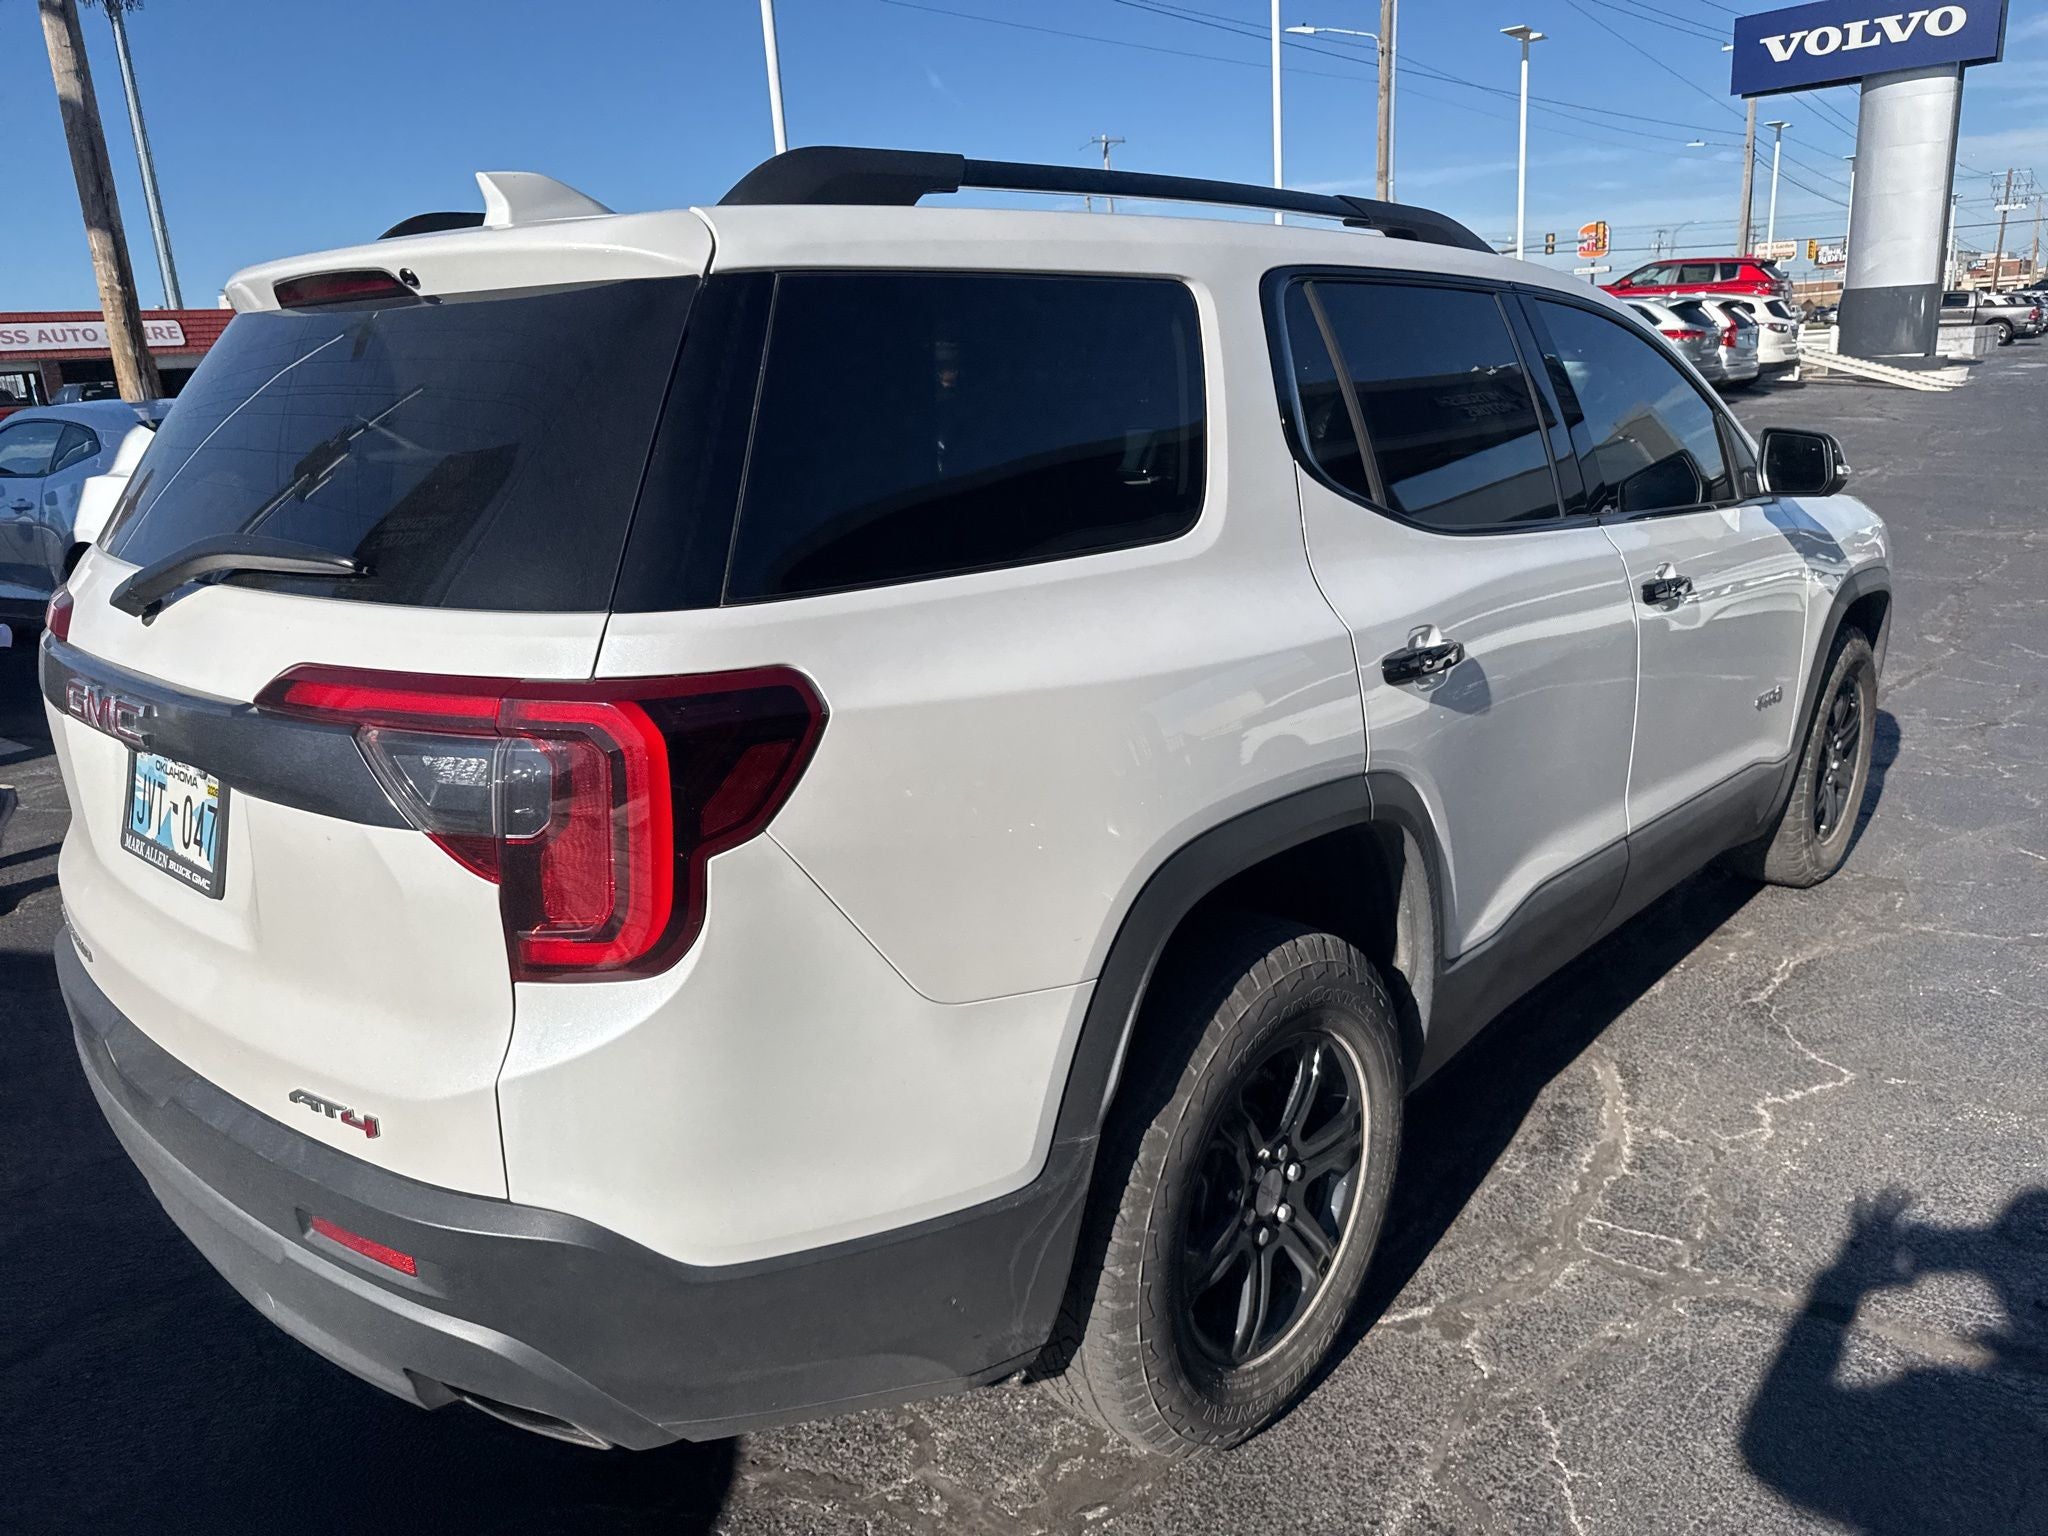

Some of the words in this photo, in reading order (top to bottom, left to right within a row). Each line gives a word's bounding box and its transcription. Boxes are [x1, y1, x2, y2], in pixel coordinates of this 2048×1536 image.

[1759, 5, 1968, 62] VOLVO
[37, 328, 98, 343] AUTO
[144, 326, 179, 340] IRE
[66, 678, 158, 747] GMC
[155, 760, 198, 789] OKLAHOMA
[136, 773, 218, 862] JVT-047
[124, 833, 145, 856] MARK
[144, 846, 169, 869] ALLEN
[168, 859, 192, 880] BUICK
[191, 872, 212, 890] GMC
[288, 1088, 381, 1139] AT4
